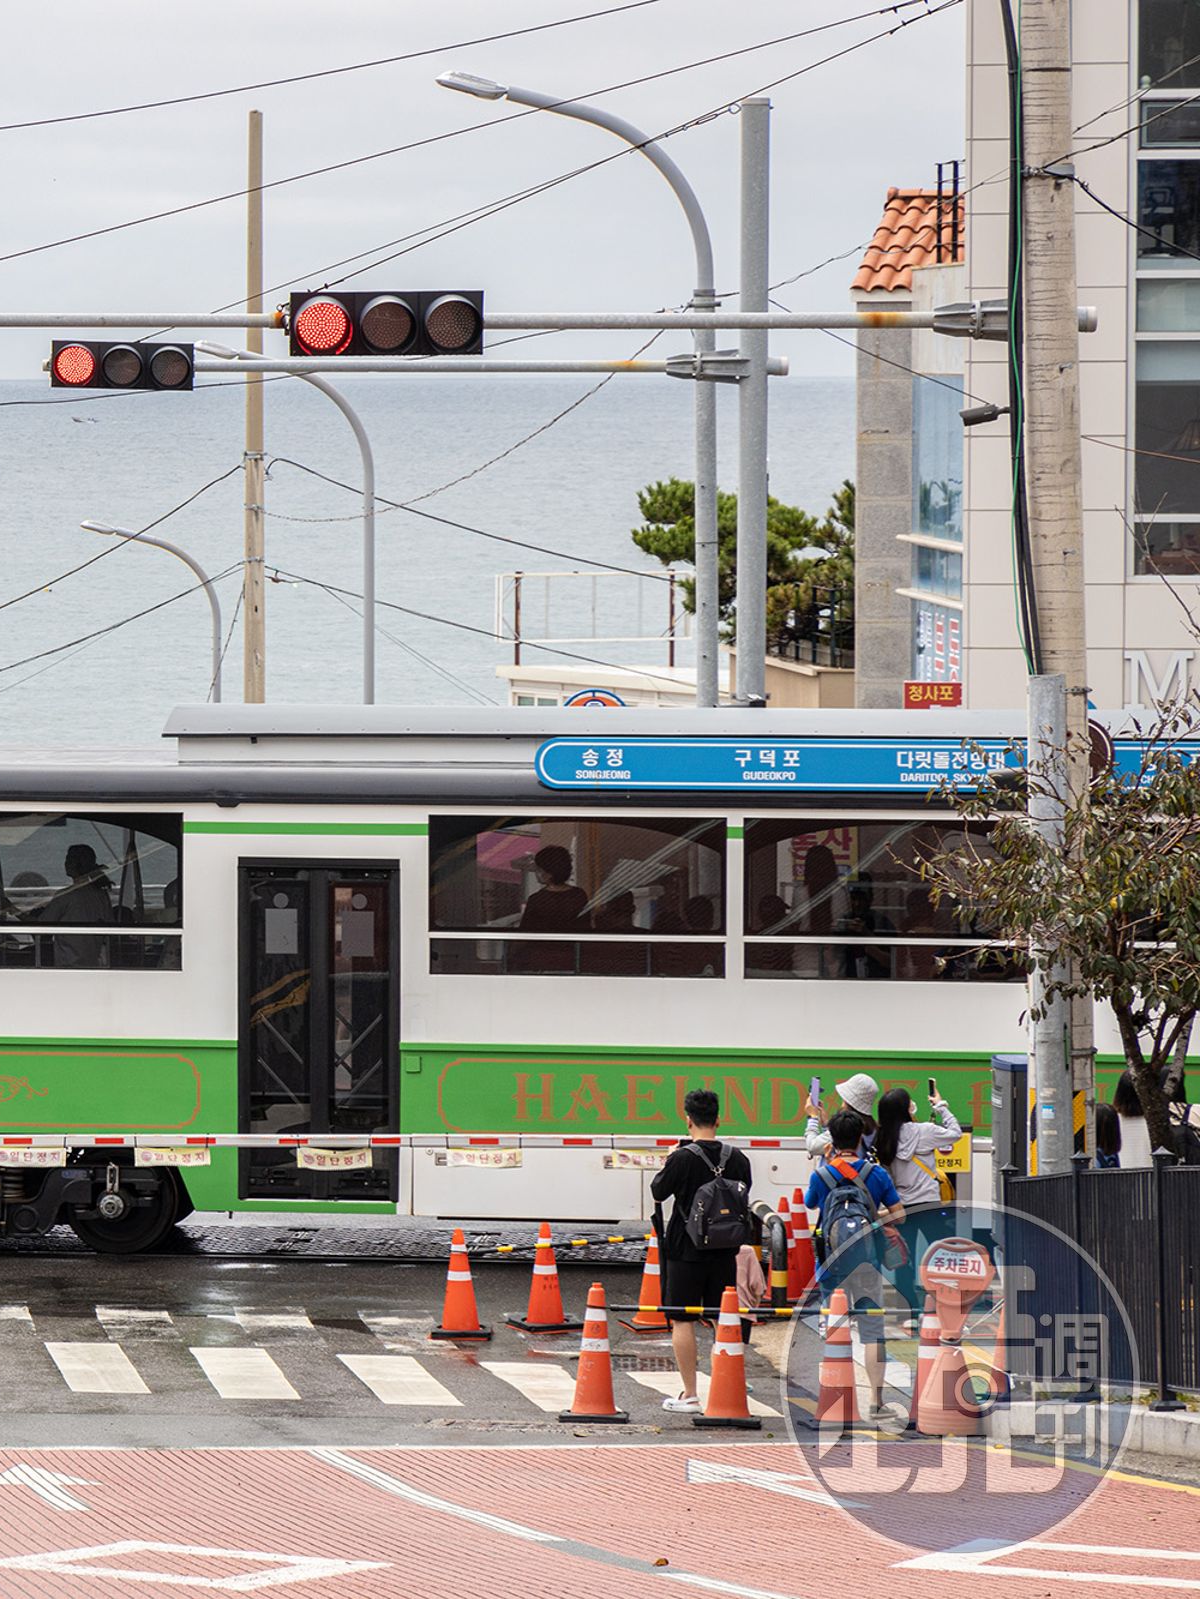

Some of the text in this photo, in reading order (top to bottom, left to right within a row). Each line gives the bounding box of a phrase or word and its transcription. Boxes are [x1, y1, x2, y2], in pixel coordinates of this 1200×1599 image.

[909, 685, 954, 702] 청사포
[734, 750, 801, 768] 구덕포
[575, 770, 631, 780] SONGJEONG
[743, 771, 796, 781] GUDEOKPO
[10, 1151, 60, 1163] 일단정지
[938, 1158, 962, 1168] 단정지
[934, 1256, 982, 1275] 주차금지
